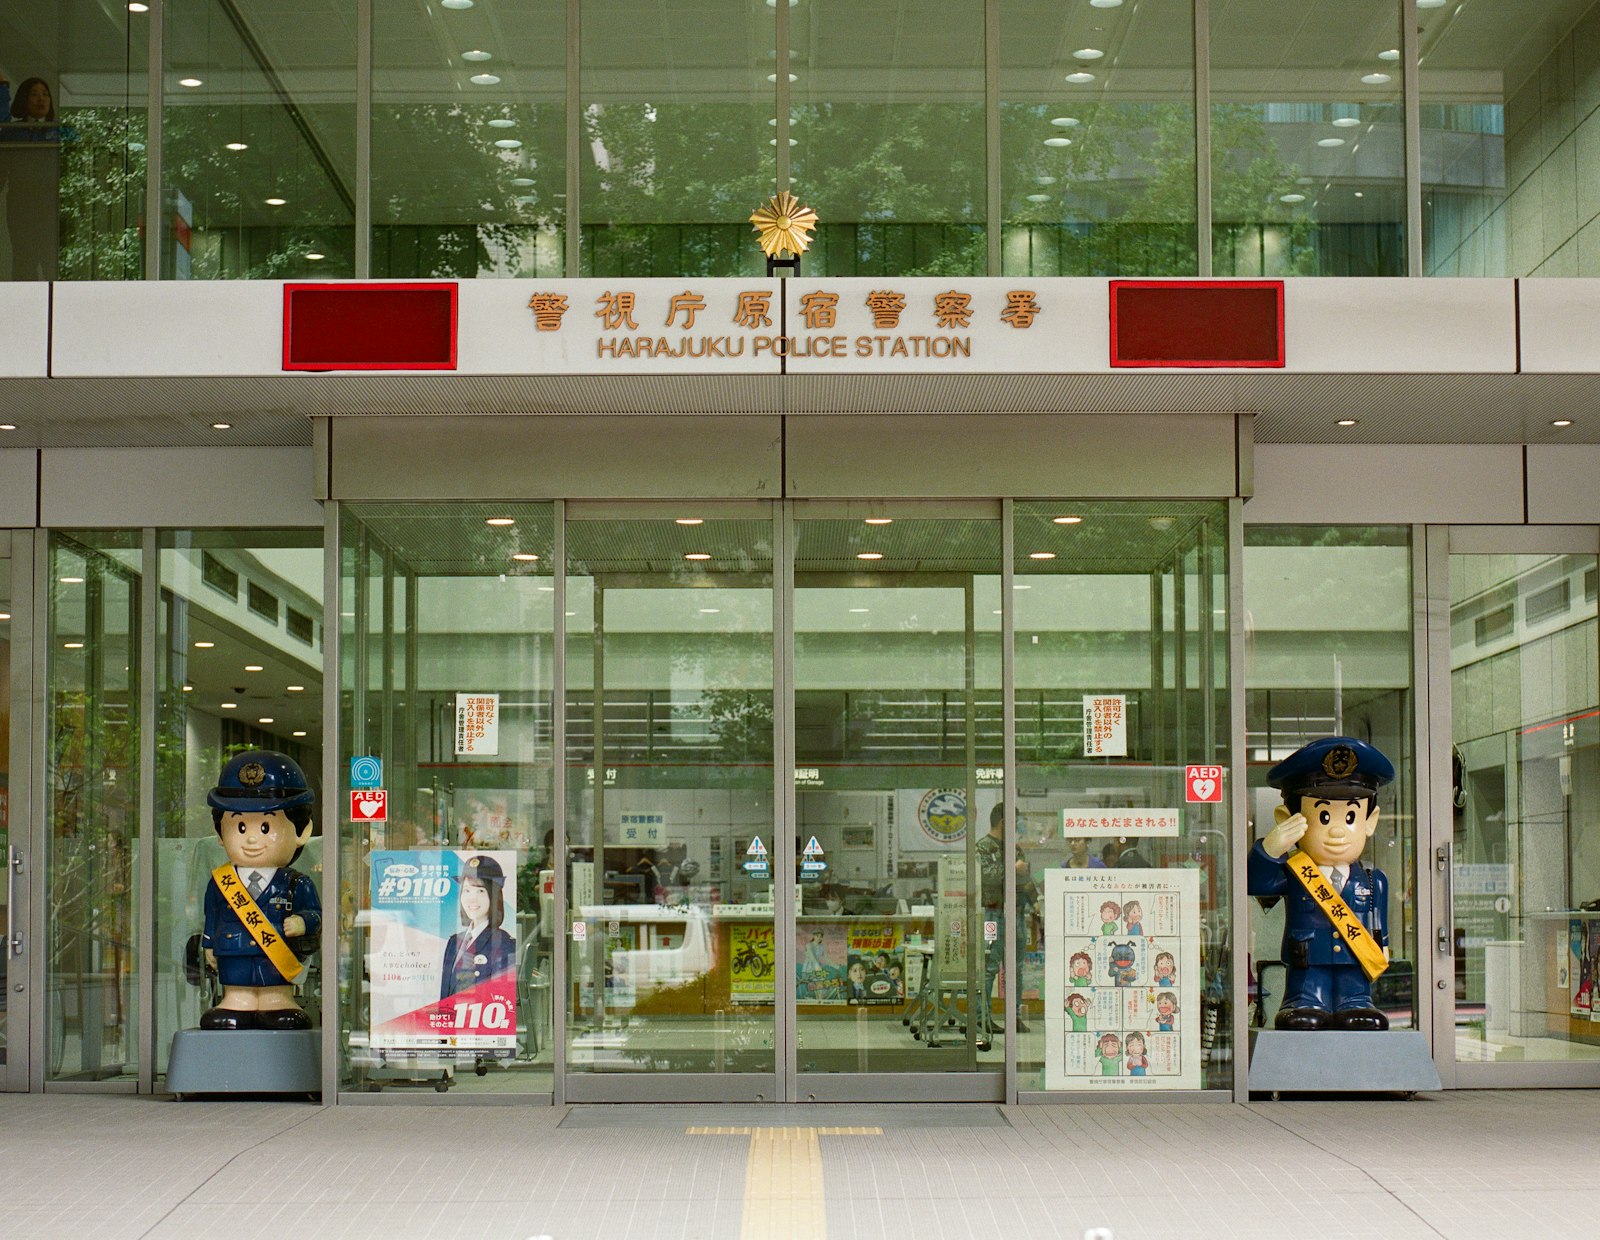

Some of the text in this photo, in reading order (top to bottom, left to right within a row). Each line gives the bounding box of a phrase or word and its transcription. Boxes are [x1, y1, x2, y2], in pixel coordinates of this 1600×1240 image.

[528, 290, 1041, 332] 警視庁原宿警察署
[598, 336, 971, 358] HARAJUKU POLICE STATION
[466, 698, 475, 751] 立入りを禁止する
[476, 698, 485, 738] 関係者以外の
[486, 698, 494, 725] 許可なく
[1103, 699, 1112, 739] 関係者以外の
[1113, 699, 1121, 725] 許可なく
[1093, 699, 1103, 753] 立入りを禁止する
[1189, 767, 1219, 778] AED
[354, 792, 384, 801] AED
[626, 828, 658, 839] 受付
[1065, 817, 1176, 828] あなたもだまされる!!
[378, 877, 451, 897] #9110
[220, 873, 277, 948] 交通安全
[1301, 865, 1361, 941] 交通安全
